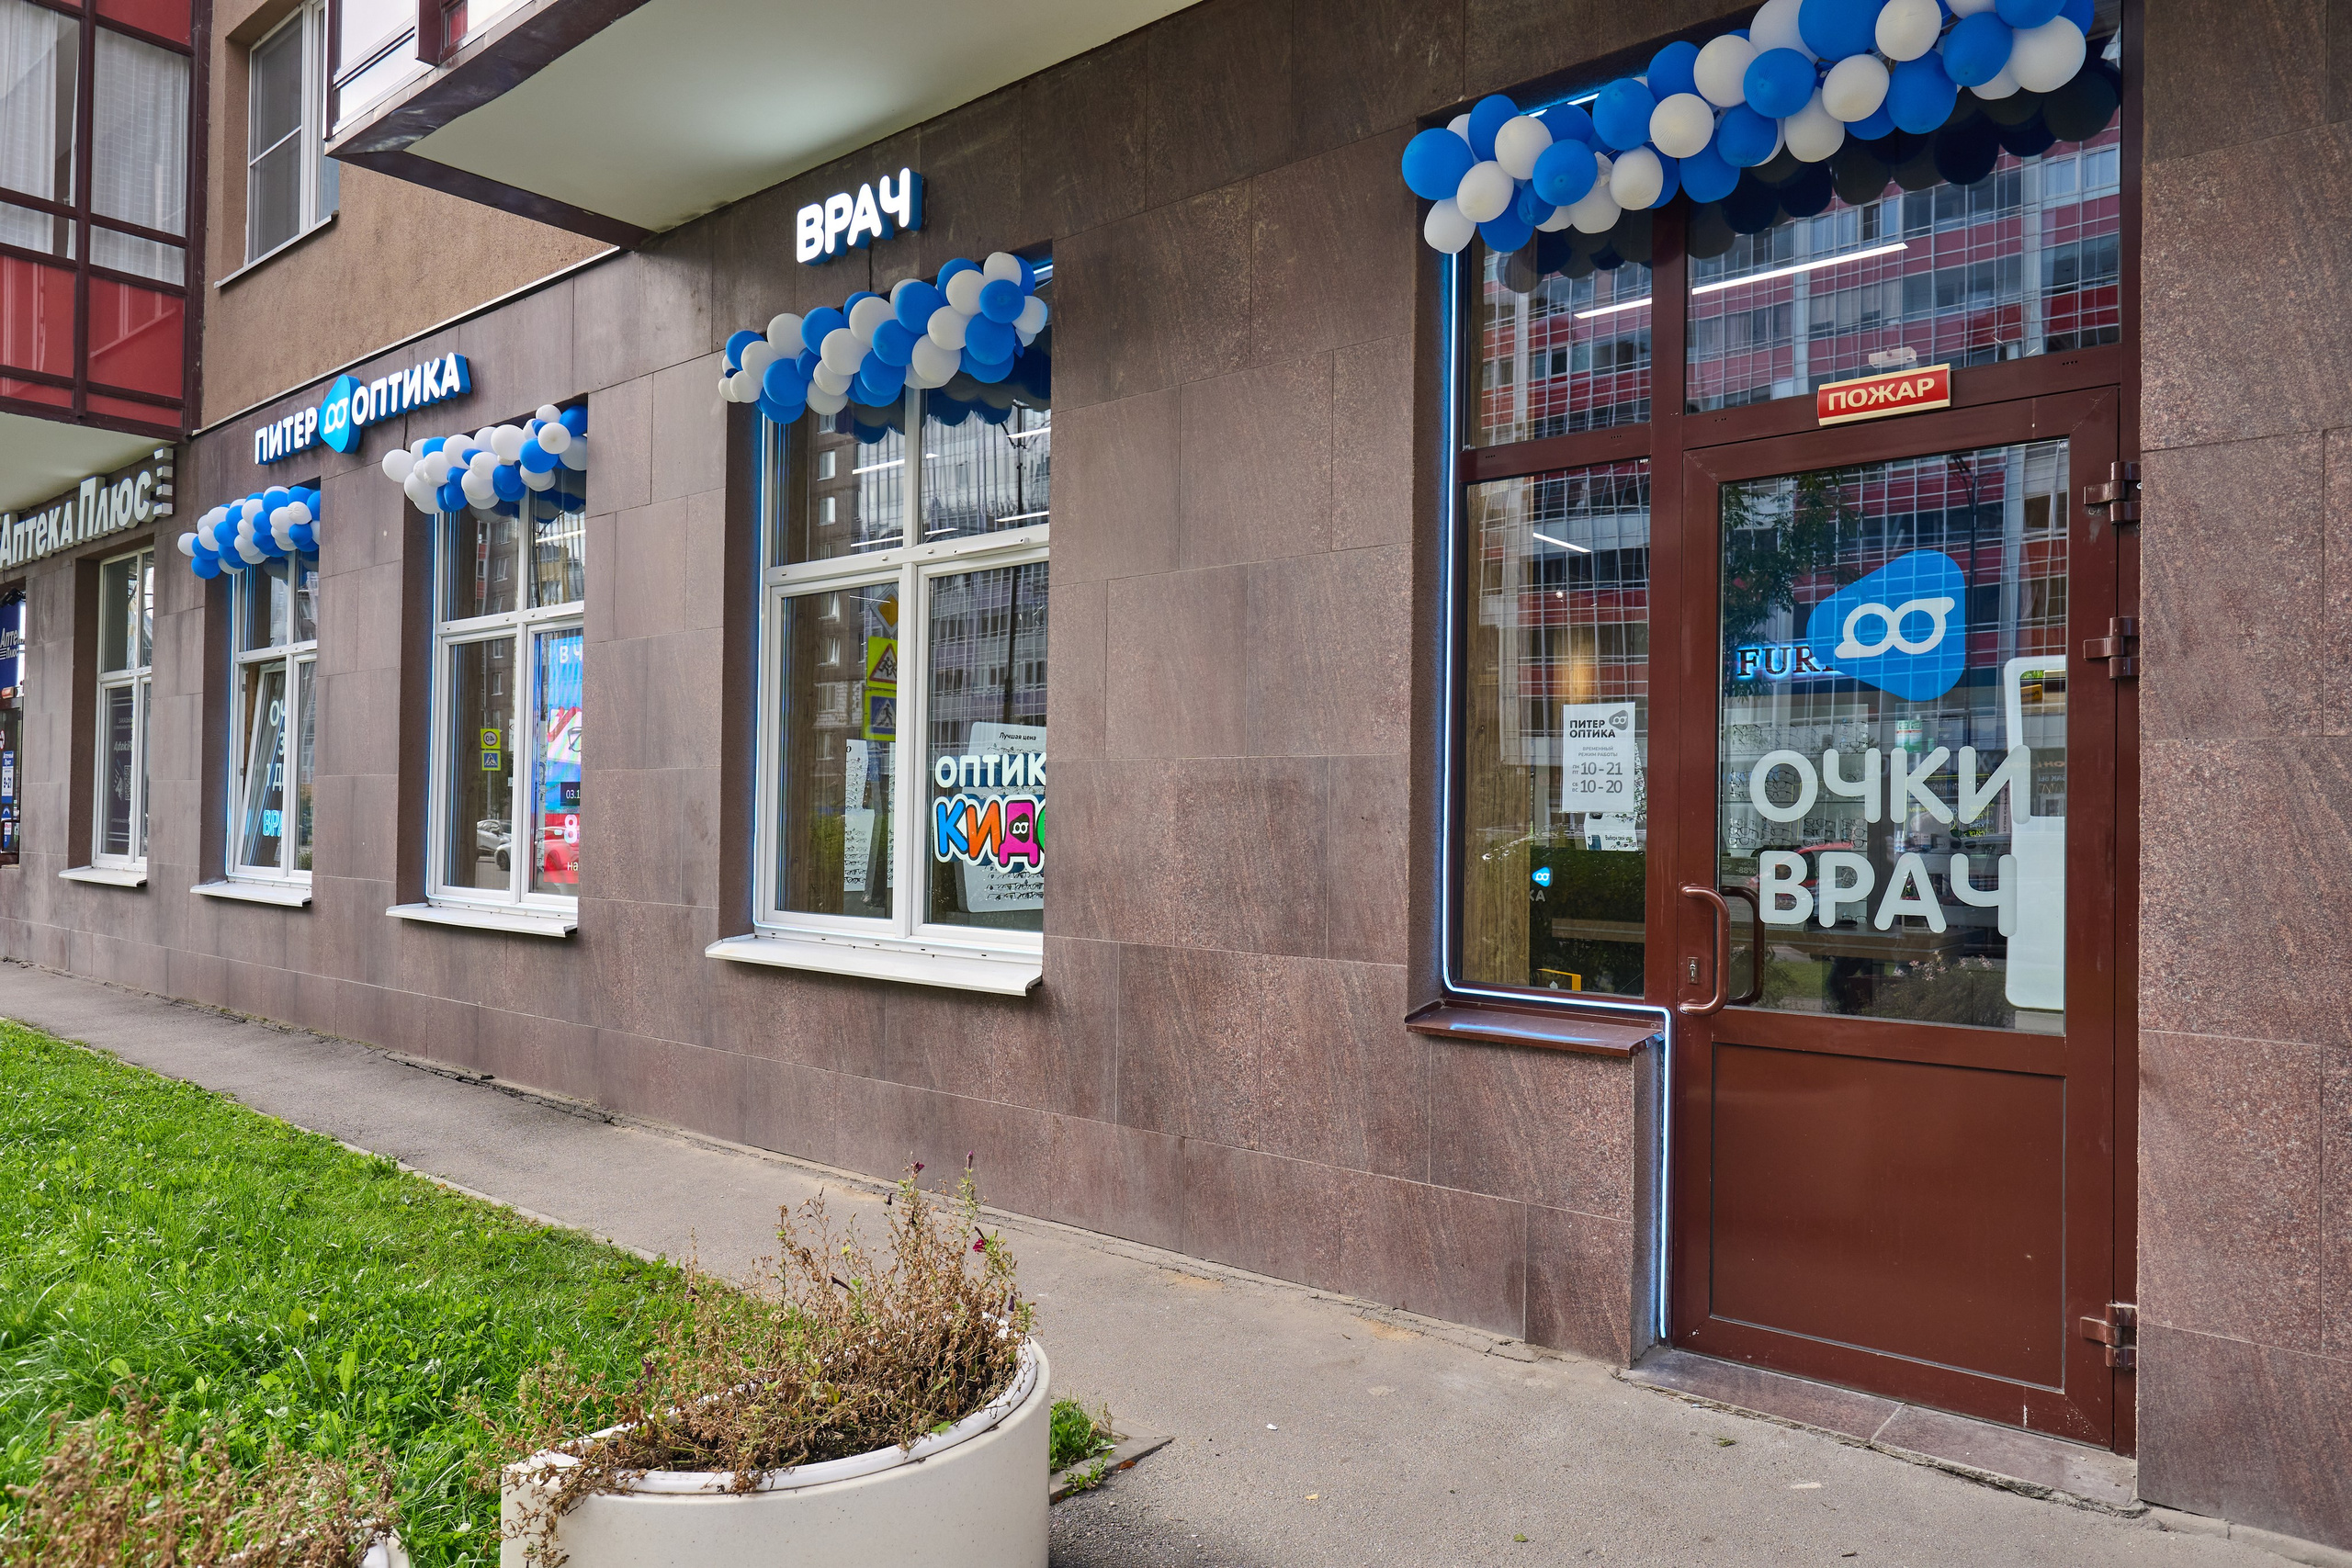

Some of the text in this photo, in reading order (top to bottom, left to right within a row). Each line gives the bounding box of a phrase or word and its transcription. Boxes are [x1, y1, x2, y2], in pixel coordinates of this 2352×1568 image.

[796, 166, 911, 264] ВРАЧ
[254, 351, 461, 465] ПИТЕР ОПТИКА
[1828, 378, 1935, 411] ПОЖАР
[1736, 645, 1836, 676] FUR
[999, 732, 1022, 740] Лучшая
[1569, 719, 1605, 728] ПИТЕР
[1569, 728, 1616, 739] ОПТИКА
[934, 752, 1046, 789] ОПТИК
[1749, 745, 2030, 824] ОЧКИ
[567, 862, 579, 872] на
[1758, 851, 2018, 938] ВРАЧ
